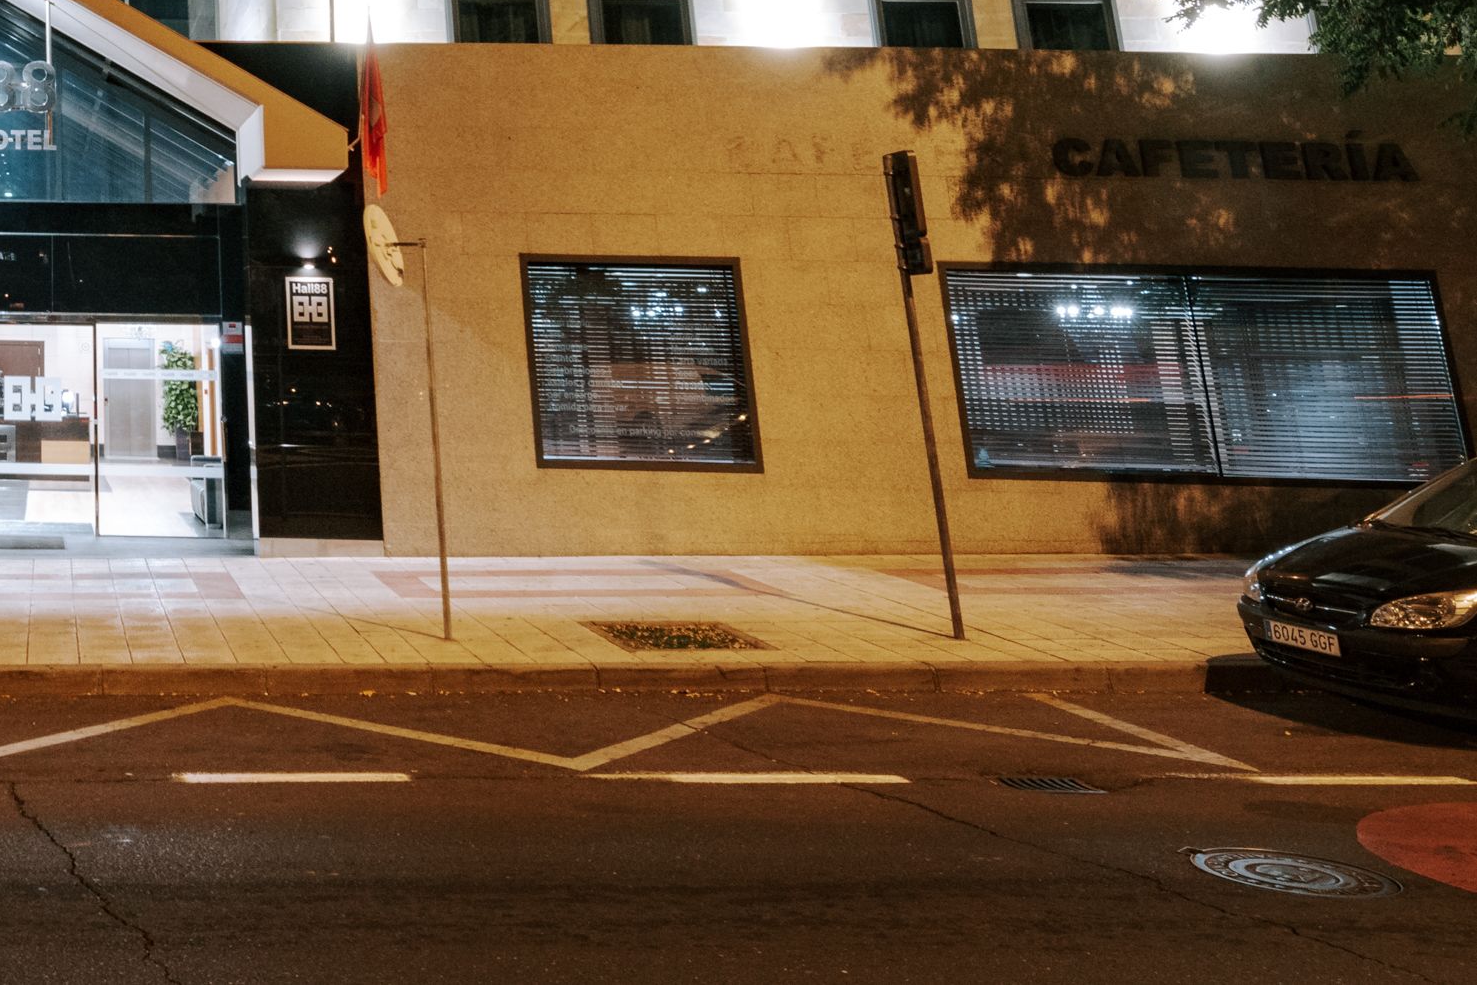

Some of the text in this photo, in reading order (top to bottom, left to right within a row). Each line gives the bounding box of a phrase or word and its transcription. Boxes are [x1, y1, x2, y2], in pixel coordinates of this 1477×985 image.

[1052, 130, 1420, 182] CAFETERÍA
[292, 283, 328, 294] Hall88
[1273, 624, 1335, 652] 6045 GGF
